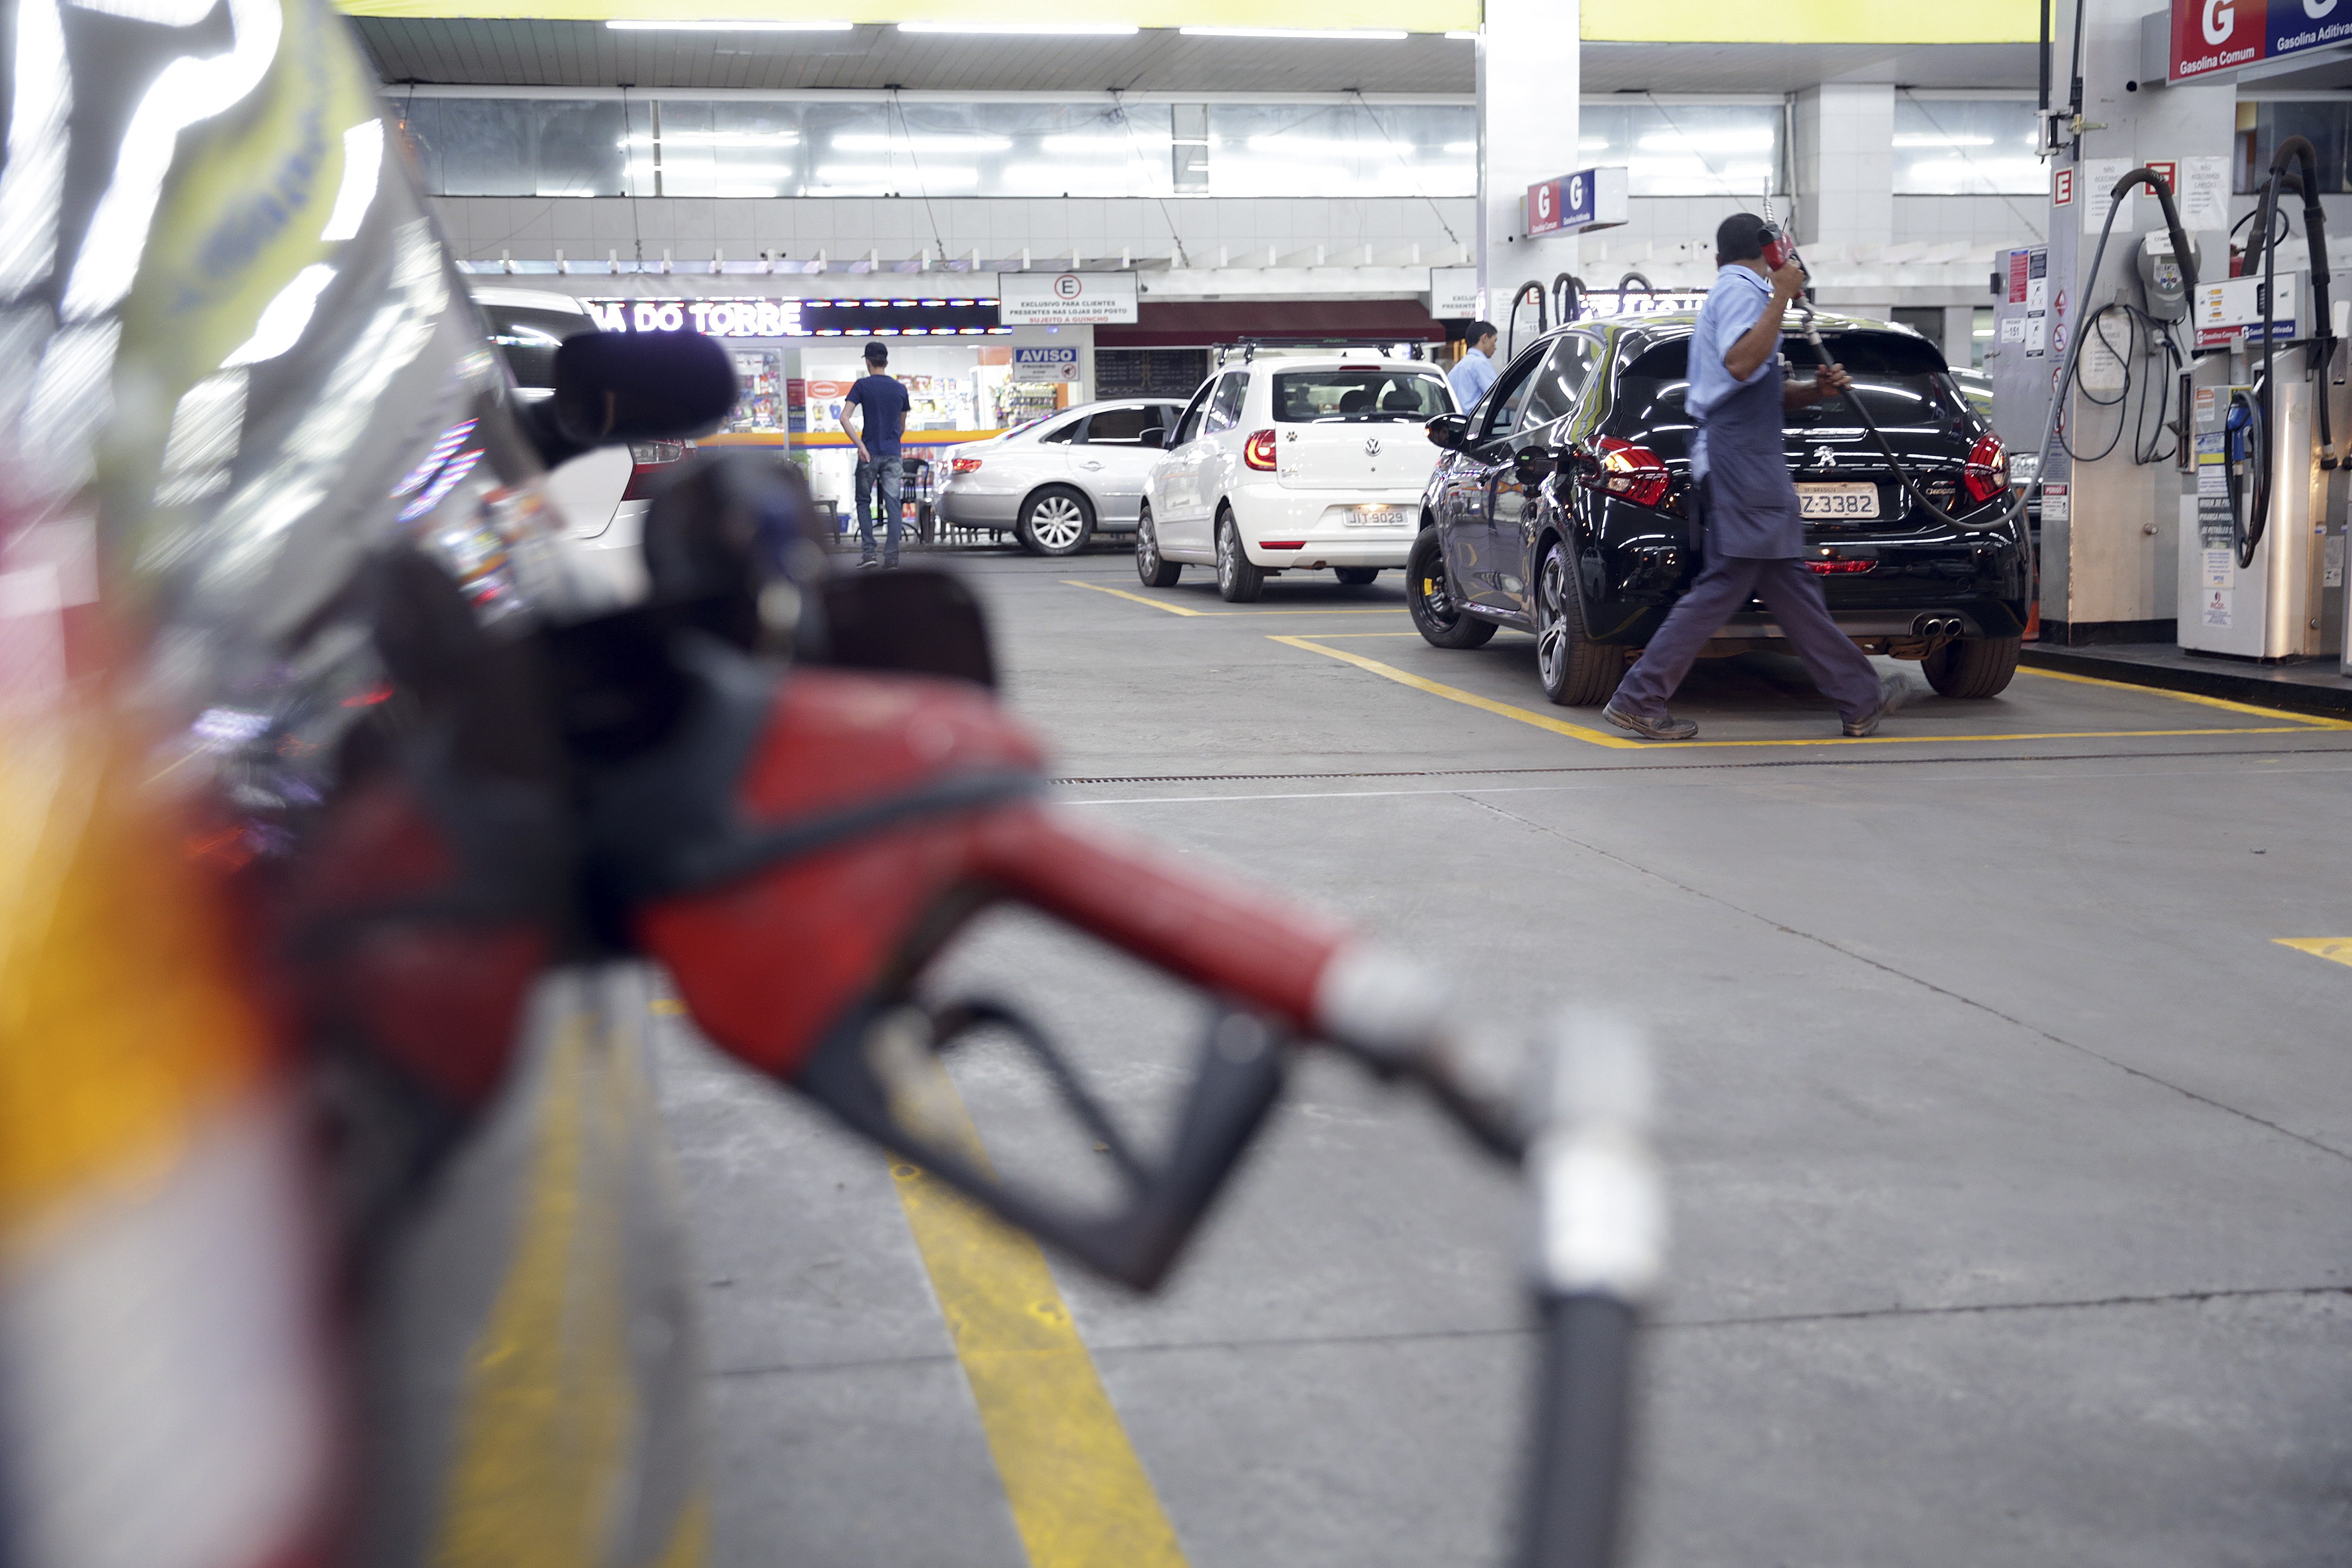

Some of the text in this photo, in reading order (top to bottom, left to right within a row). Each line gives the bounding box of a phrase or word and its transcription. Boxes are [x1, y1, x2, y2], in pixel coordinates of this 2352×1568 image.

[2202, 0, 2234, 45] G
[2277, 32, 2316, 51] Gasolina
[2180, 47, 2255, 75] Gasolina Comum
[1570, 176, 1582, 210] G
[2057, 176, 2070, 201] E
[1538, 185, 1551, 219] G
[1062, 280, 1074, 294] E
[634, 303, 683, 332] DO
[689, 303, 802, 335] TORRE
[2197, 330, 2203, 344] G
[2241, 326, 2250, 339] G
[1020, 350, 1073, 361] AVISO
[1800, 496, 1872, 513] Z-3382
[1350, 513, 1403, 523] JIT-9029
